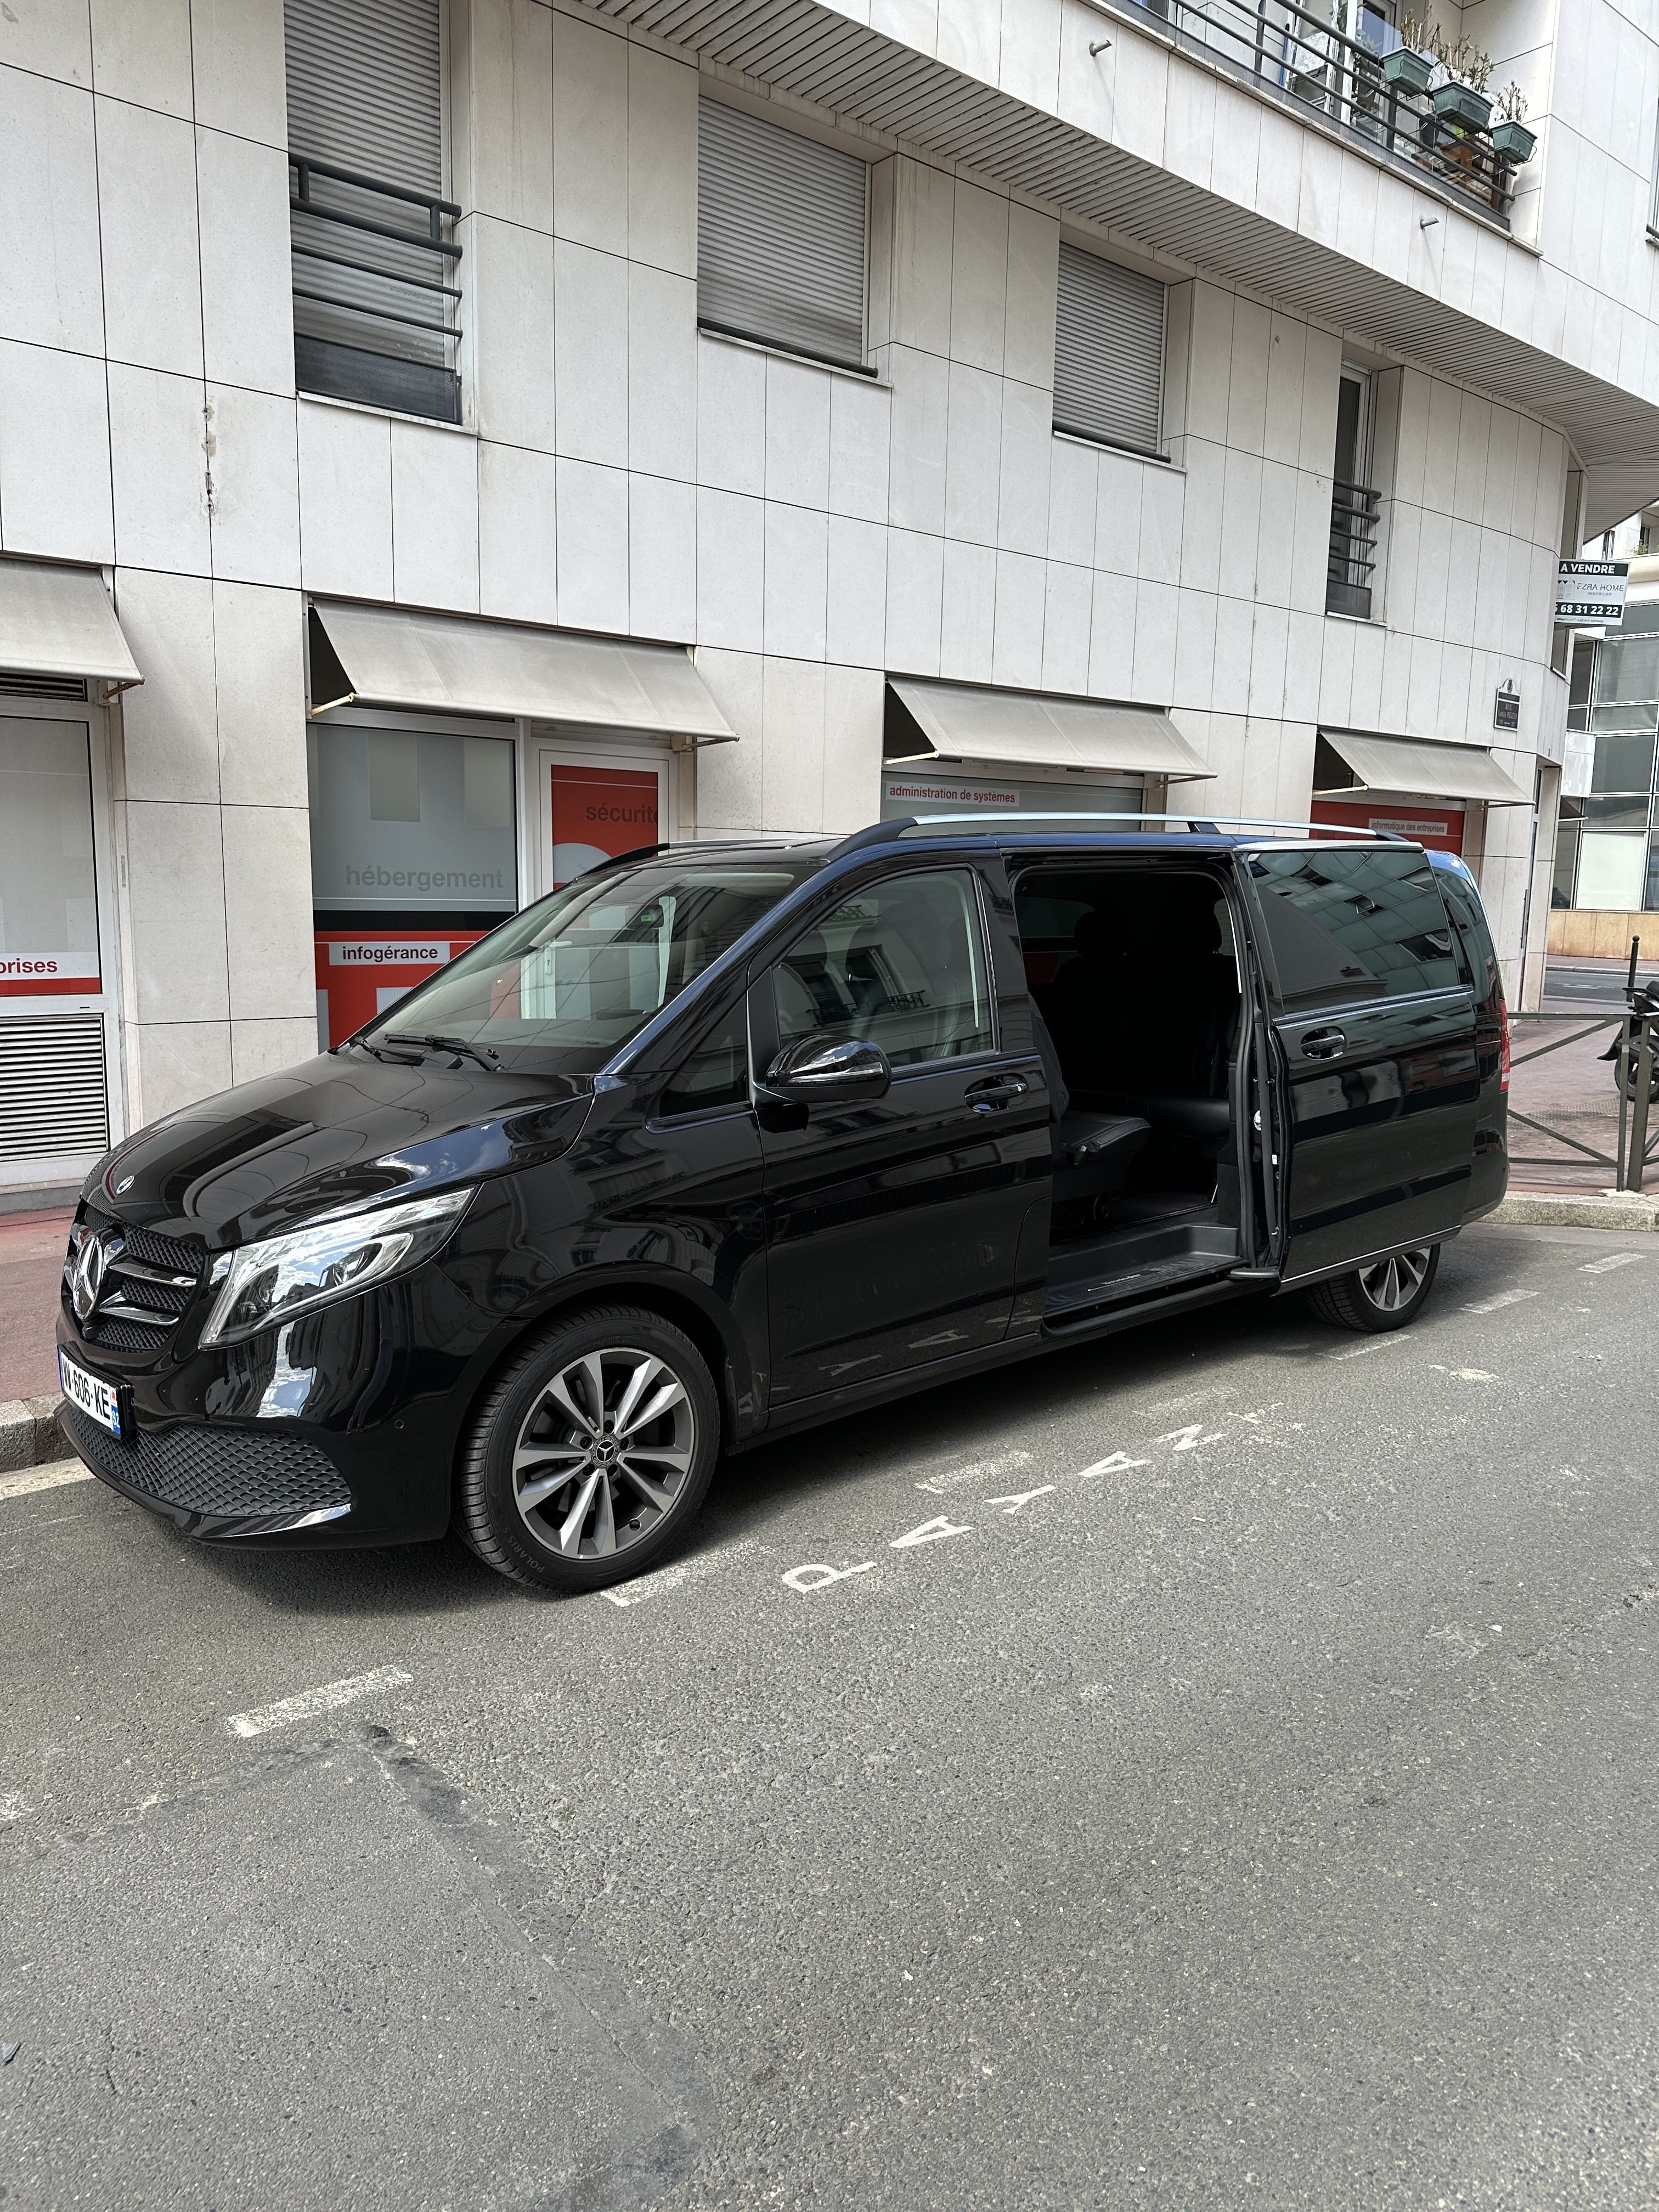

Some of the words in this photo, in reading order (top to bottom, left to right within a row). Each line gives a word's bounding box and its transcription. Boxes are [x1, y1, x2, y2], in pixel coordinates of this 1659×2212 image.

[1560, 563, 1568, 572] A
[1571, 563, 1616, 574] VENDRE
[1560, 605, 1573, 613] 68
[1575, 605, 1588, 614] 31
[1590, 606, 1604, 614] 22
[1605, 606, 1619, 615] 22
[890, 786, 957, 800] administration
[960, 789, 971, 800] de
[973, 791, 1015, 803] systèmes
[1372, 820, 1405, 832] informatique
[1406, 823, 1416, 831] des
[1417, 823, 1445, 833] entreprises
[345, 865, 504, 892] hébergement
[342, 945, 438, 963] infogérance
[112, 1410, 120, 1428] 92
[507, 1536, 545, 1573] POLARIS
